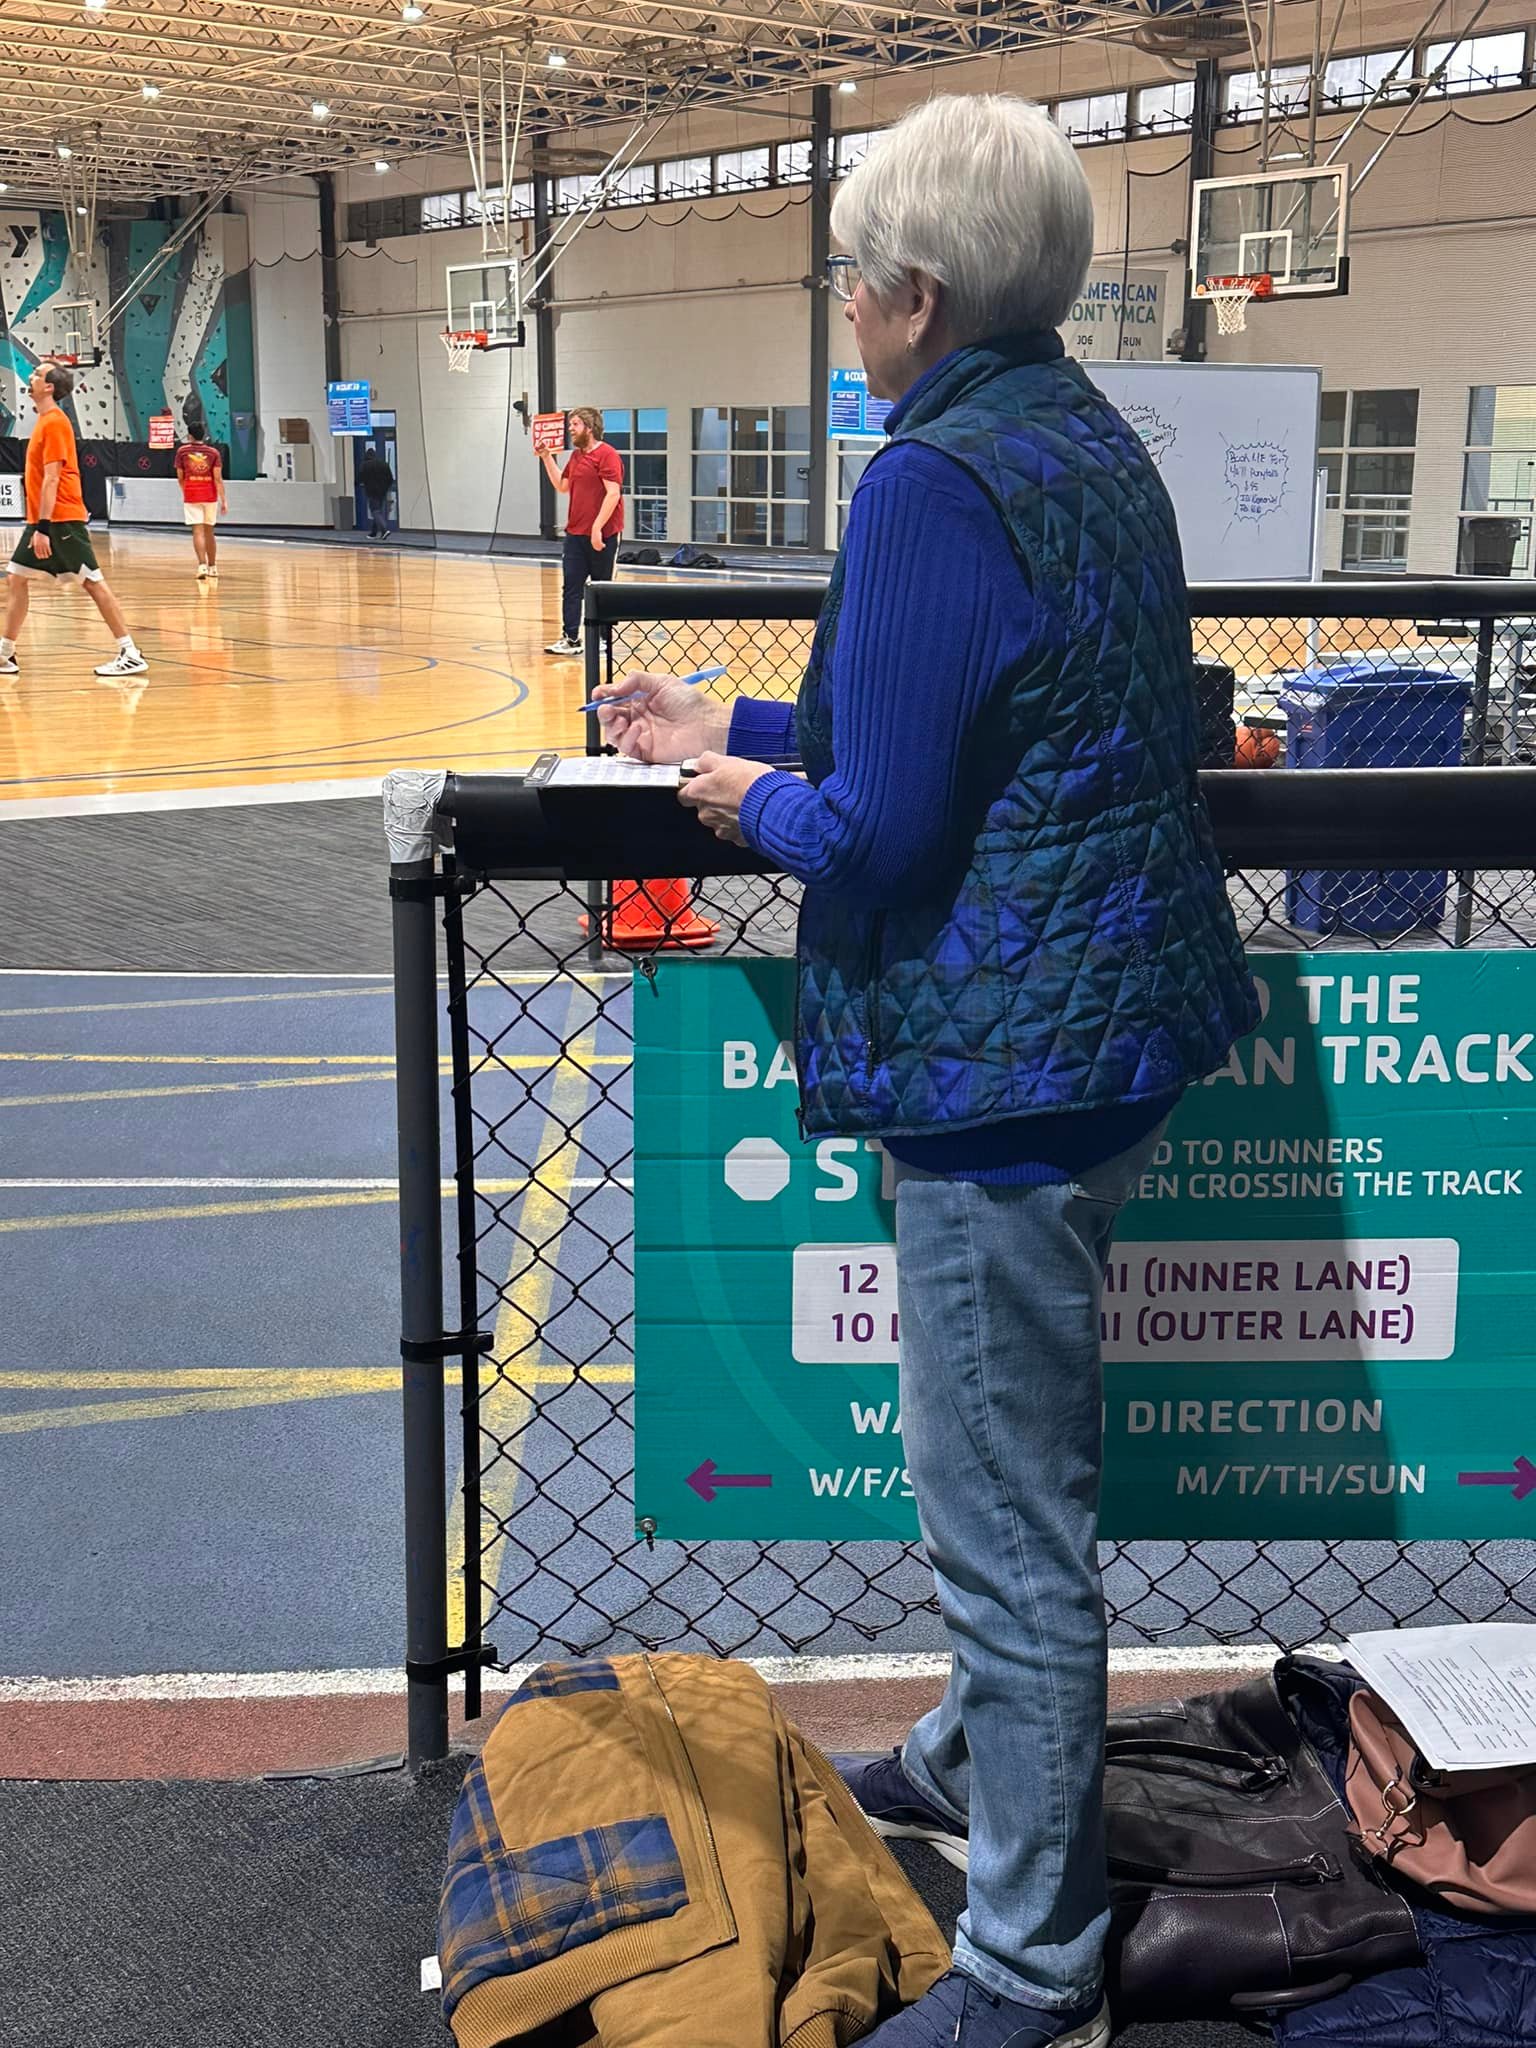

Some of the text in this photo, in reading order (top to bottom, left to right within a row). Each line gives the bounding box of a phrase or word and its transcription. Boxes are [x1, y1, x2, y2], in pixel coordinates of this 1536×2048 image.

[1083, 282, 1158, 302] MERICAN
[1068, 302, 1156, 324] ONT YMCA
[1123, 336, 1142, 347] RUN
[1296, 974, 1421, 1025] THE
[722, 1033, 1535, 1089] BA AN TRACK
[814, 1137, 899, 1202] ST
[1182, 1139, 1224, 1166] TO
[1233, 1137, 1384, 1166] RUNNERS
[1129, 1169, 1524, 1200] EN CROSSING THE TRACK
[838, 1263, 879, 1294] 12
[1144, 1256, 1279, 1298] (INNER
[1295, 1254, 1411, 1296] LANE)
[831, 1312, 875, 1343] 10
[1137, 1305, 1283, 1347] (OUTER
[1299, 1303, 1415, 1345] LANE)
[1127, 1398, 1383, 1433] DIRECTION
[1176, 1463, 1426, 1496] M/T/TH/SUN
